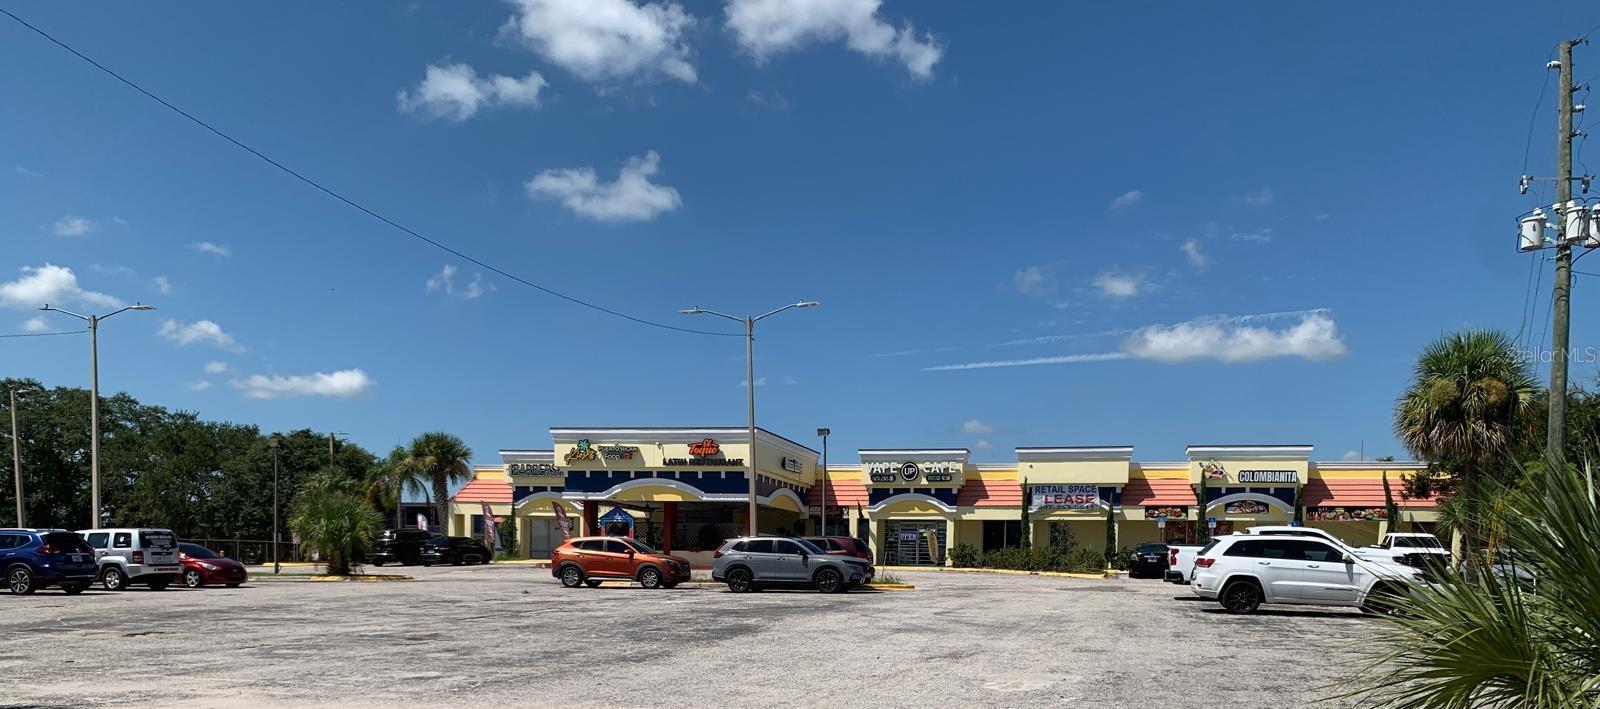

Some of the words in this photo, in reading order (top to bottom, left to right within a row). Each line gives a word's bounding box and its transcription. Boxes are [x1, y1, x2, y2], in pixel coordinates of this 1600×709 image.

[688, 442, 719, 458] Toque
[866, 462, 898, 473] VAPE
[923, 462, 956, 473] CAFE
[1239, 471, 1297, 482] COLOMBIANITA
[1044, 494, 1095, 504] LEASE
[900, 532, 917, 540] OPEN
